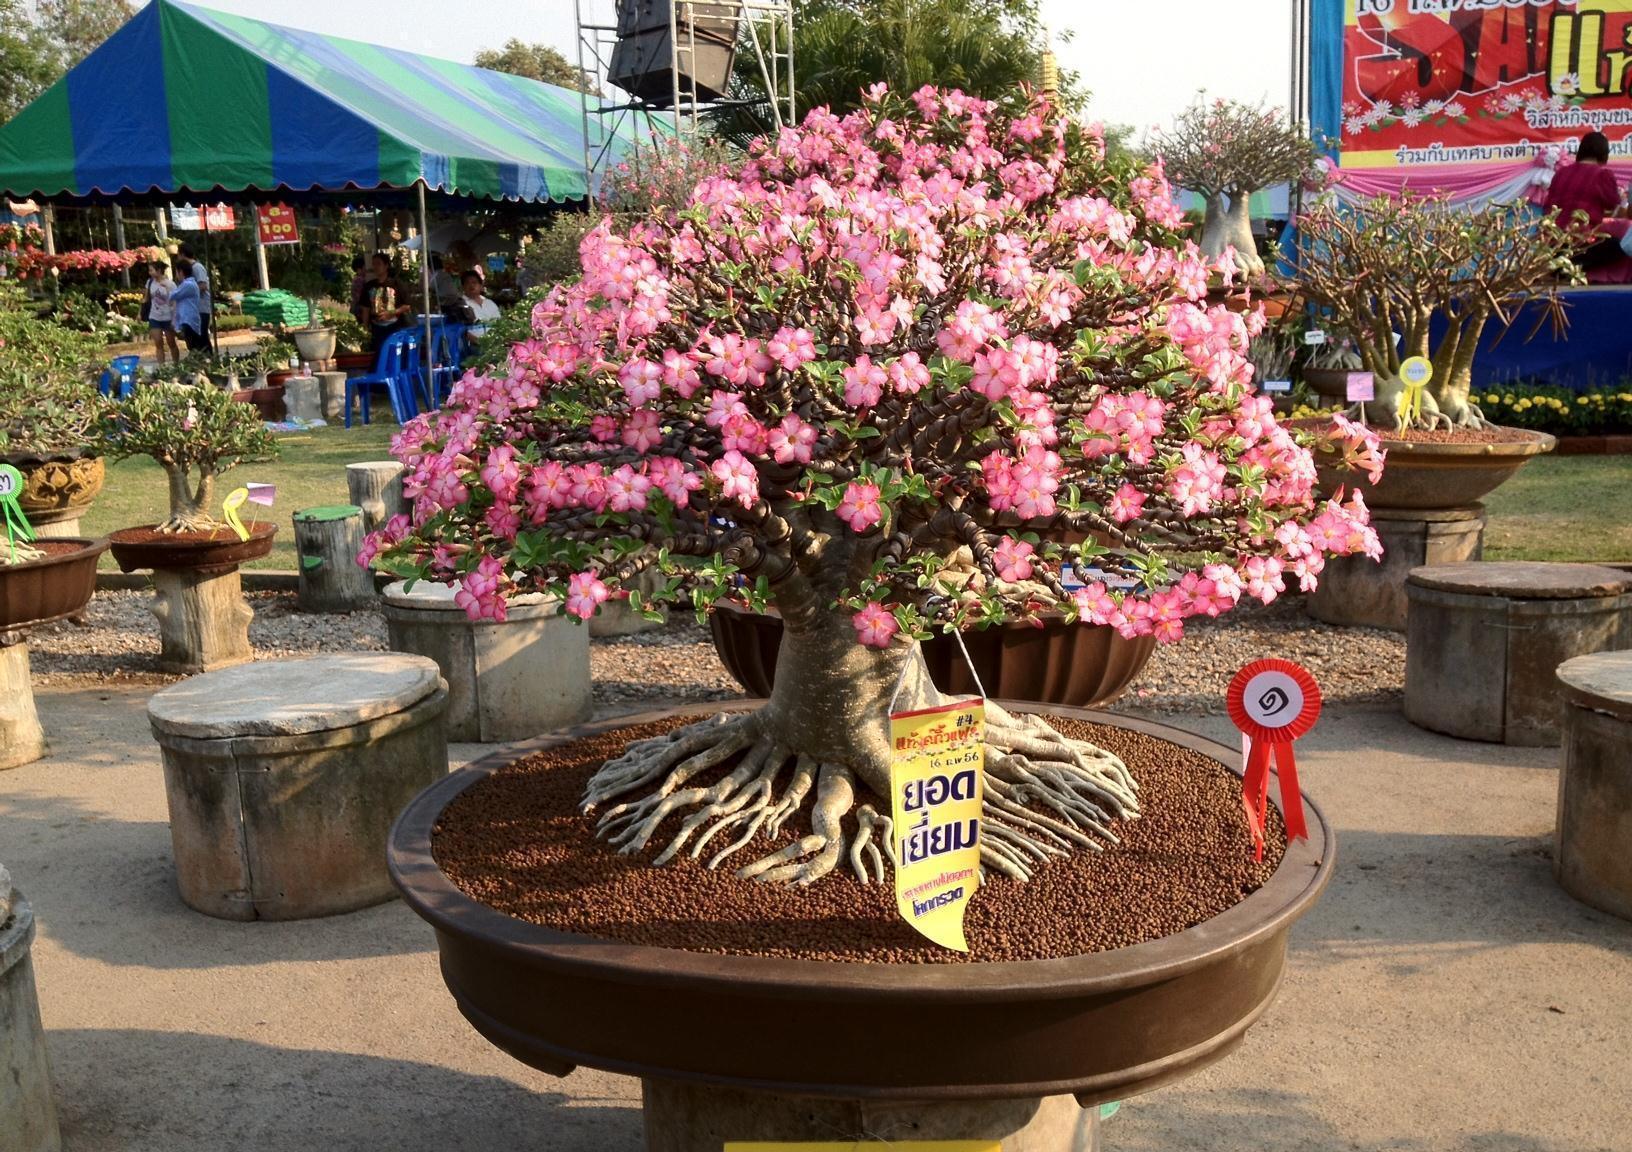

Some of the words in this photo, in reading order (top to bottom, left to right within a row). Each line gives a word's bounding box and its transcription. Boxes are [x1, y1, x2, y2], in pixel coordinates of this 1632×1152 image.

[262, 223, 292, 234] 100
[903, 769, 976, 812] ยอด
[901, 811, 978, 866] เยี่ยม
